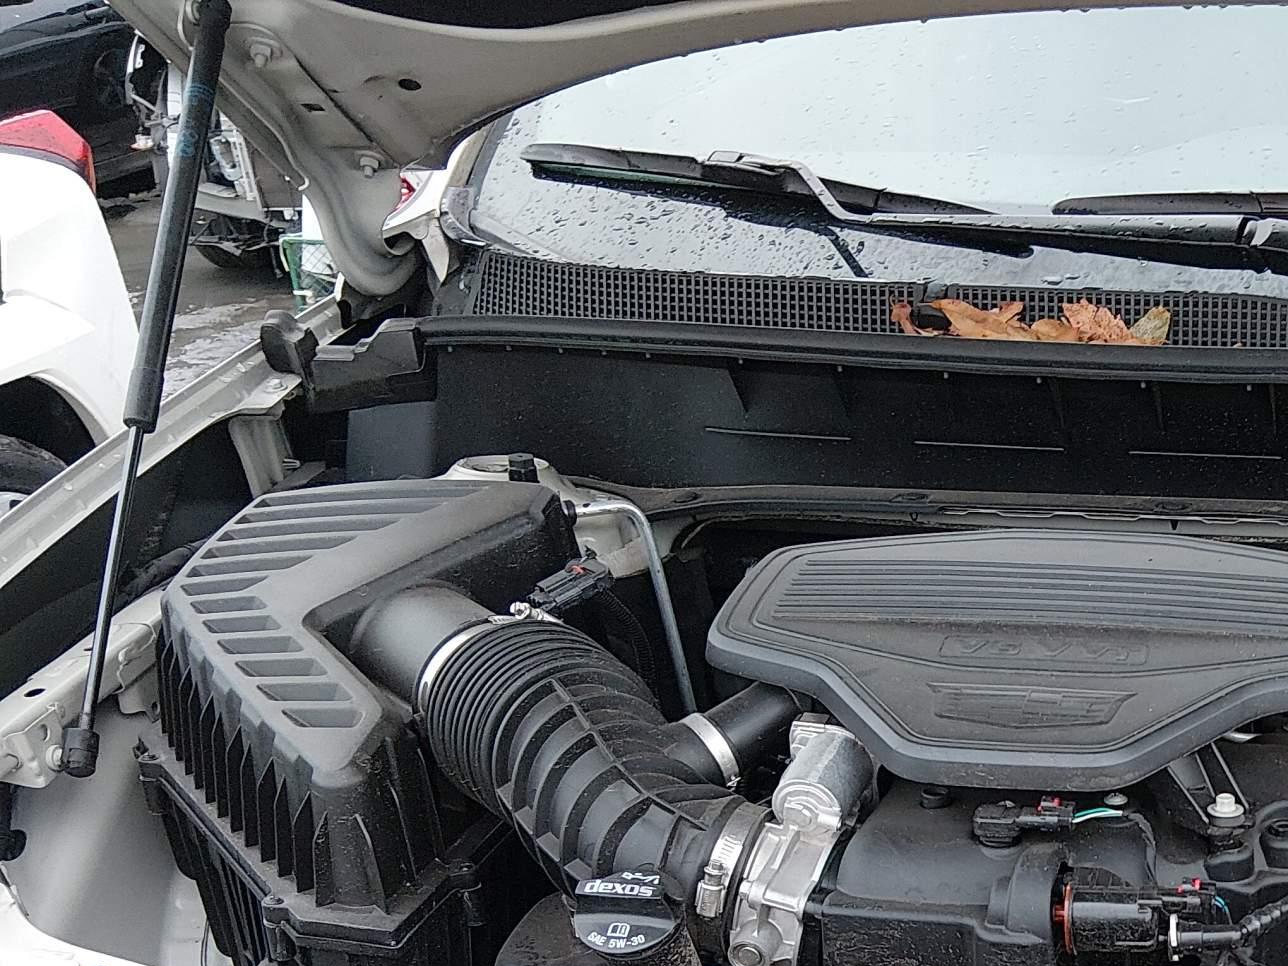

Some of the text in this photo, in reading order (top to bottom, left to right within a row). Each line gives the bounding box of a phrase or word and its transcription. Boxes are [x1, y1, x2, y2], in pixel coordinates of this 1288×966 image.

[583, 878, 657, 897] dexos
[587, 931, 646, 949] SAE 5W-30
